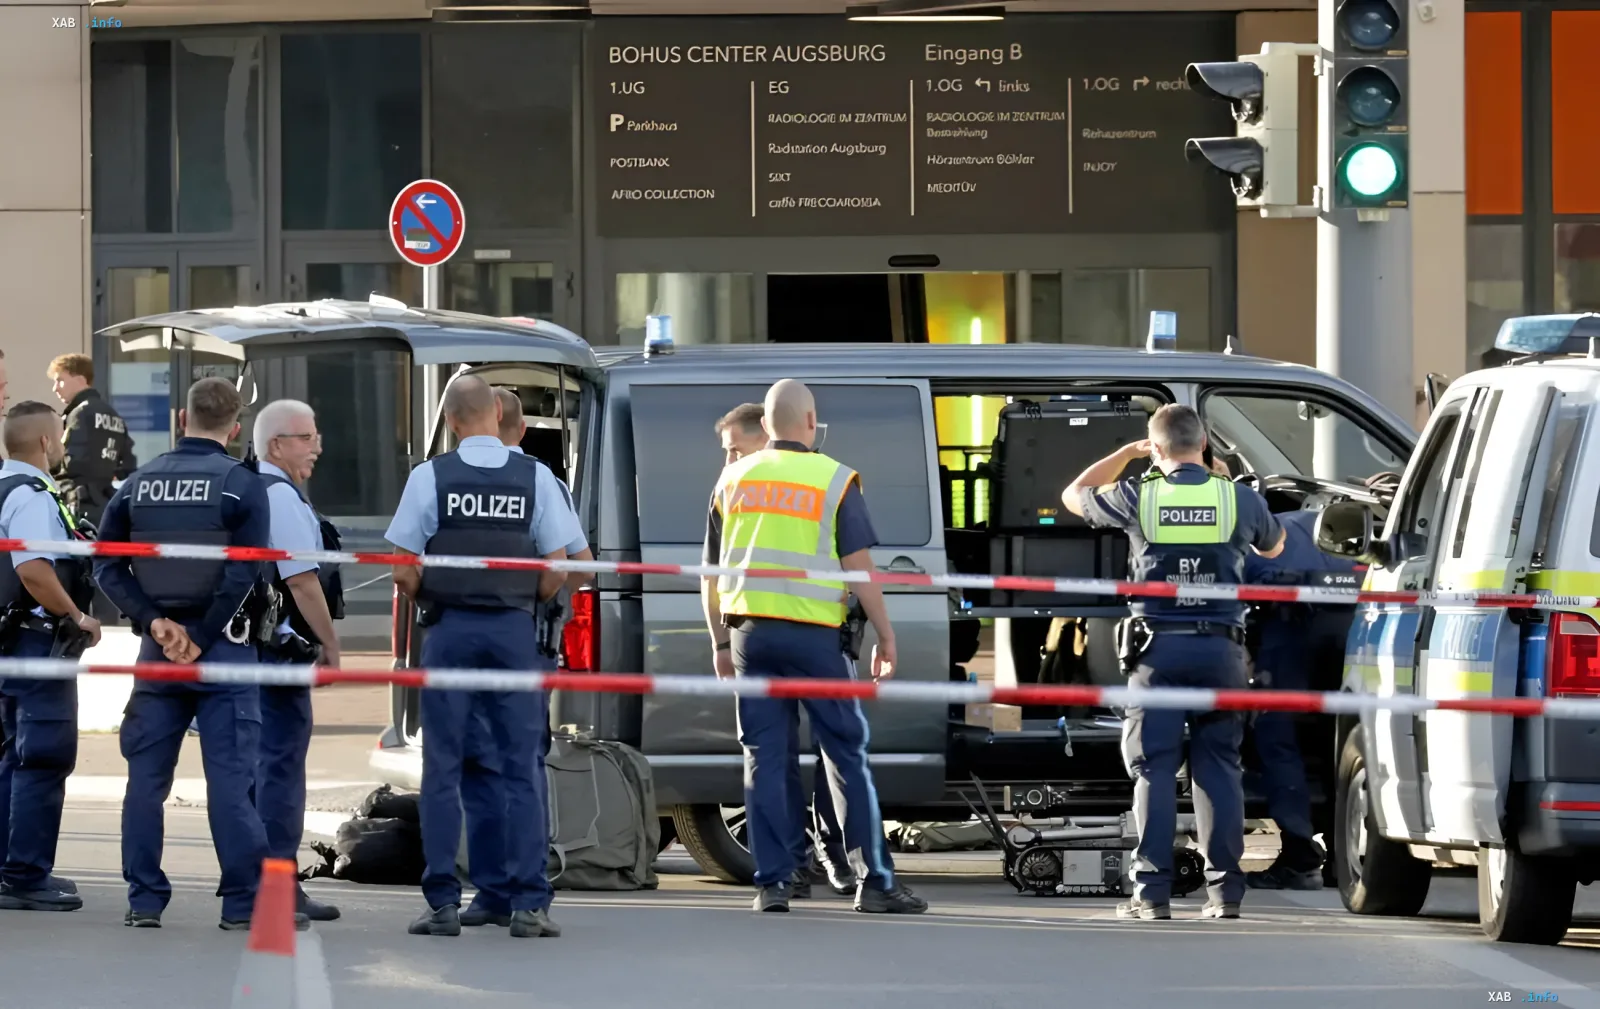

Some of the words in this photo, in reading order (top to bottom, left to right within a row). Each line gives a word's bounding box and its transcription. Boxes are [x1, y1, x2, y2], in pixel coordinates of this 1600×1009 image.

[609, 46, 682, 63] BOHUS
[687, 46, 767, 63] CENTER
[772, 44, 886, 62] AUGSBURG
[925, 44, 1004, 65] Eingang
[1010, 43, 1023, 60] B
[768, 81, 790, 94] EG
[926, 79, 963, 92] 1.OG
[998, 80, 1031, 92] links
[1083, 77, 1120, 91] 1.OG
[610, 113, 625, 132] P
[644, 188, 716, 199] COLLECTION
[136, 479, 212, 502] POLIZEI
[732, 484, 817, 514] OLIZEI
[446, 492, 527, 520] POLIZEI
[1160, 509, 1217, 523] POLIZEI
[1179, 557, 1202, 574] BY
